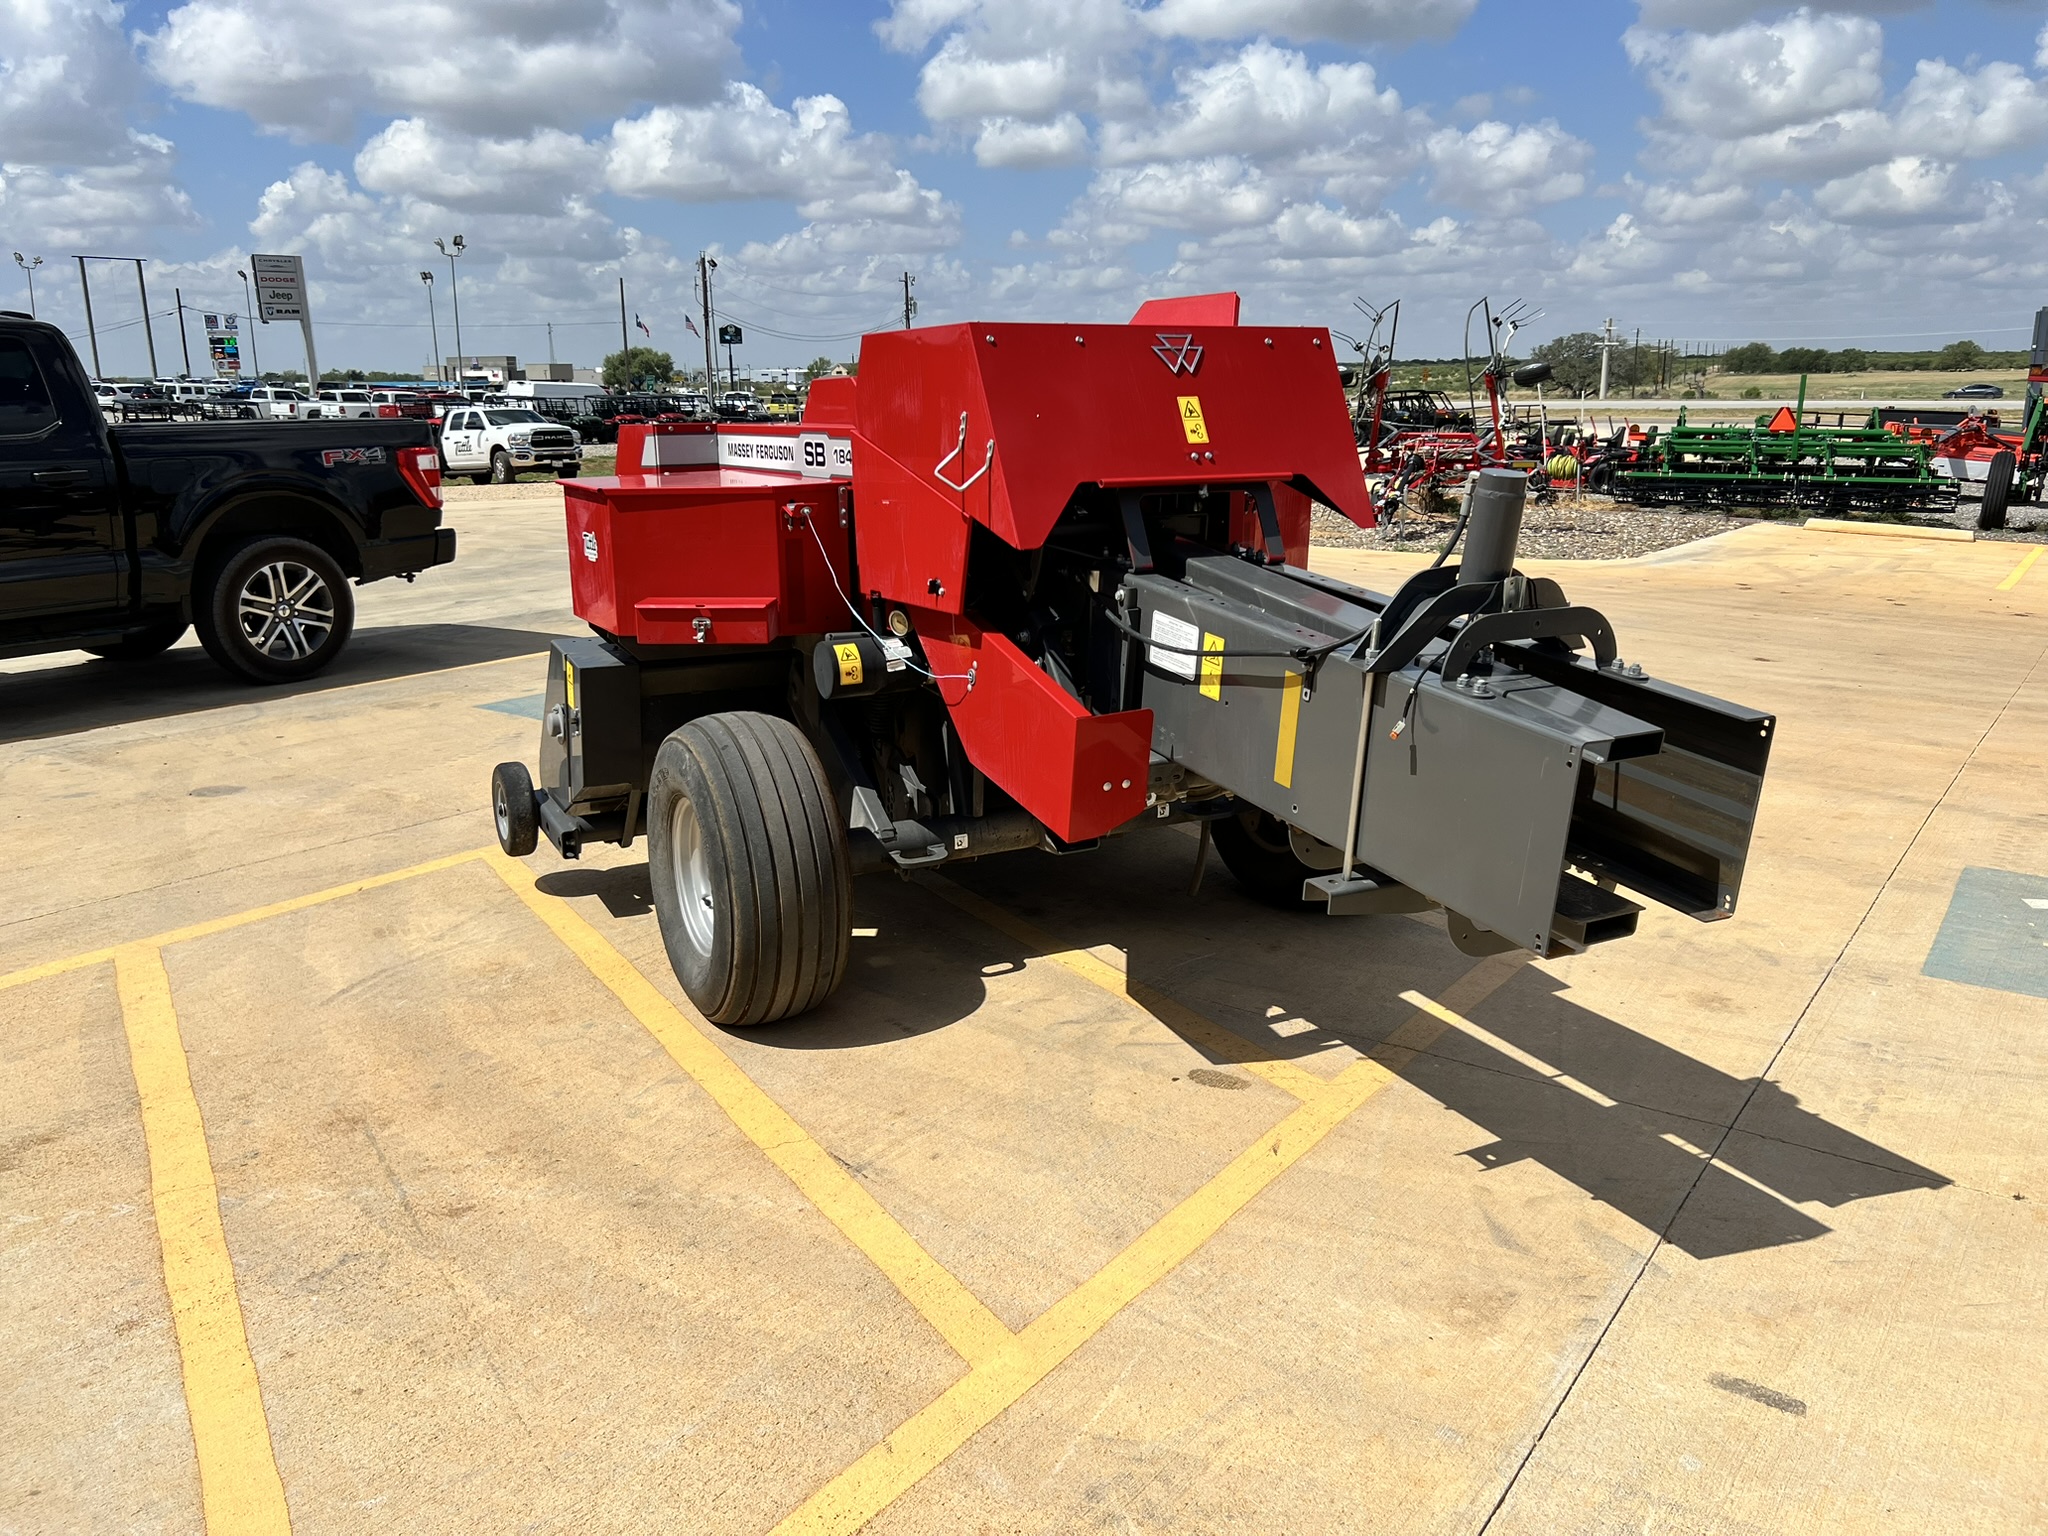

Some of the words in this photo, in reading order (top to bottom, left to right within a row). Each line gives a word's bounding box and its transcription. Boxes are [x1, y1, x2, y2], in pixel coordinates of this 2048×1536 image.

[269, 290, 293, 301] Jeep
[321, 446, 386, 468] FX4
[727, 442, 754, 458] MASSEY
[756, 444, 795, 461] FERGUSON
[803, 441, 826, 467] SB
